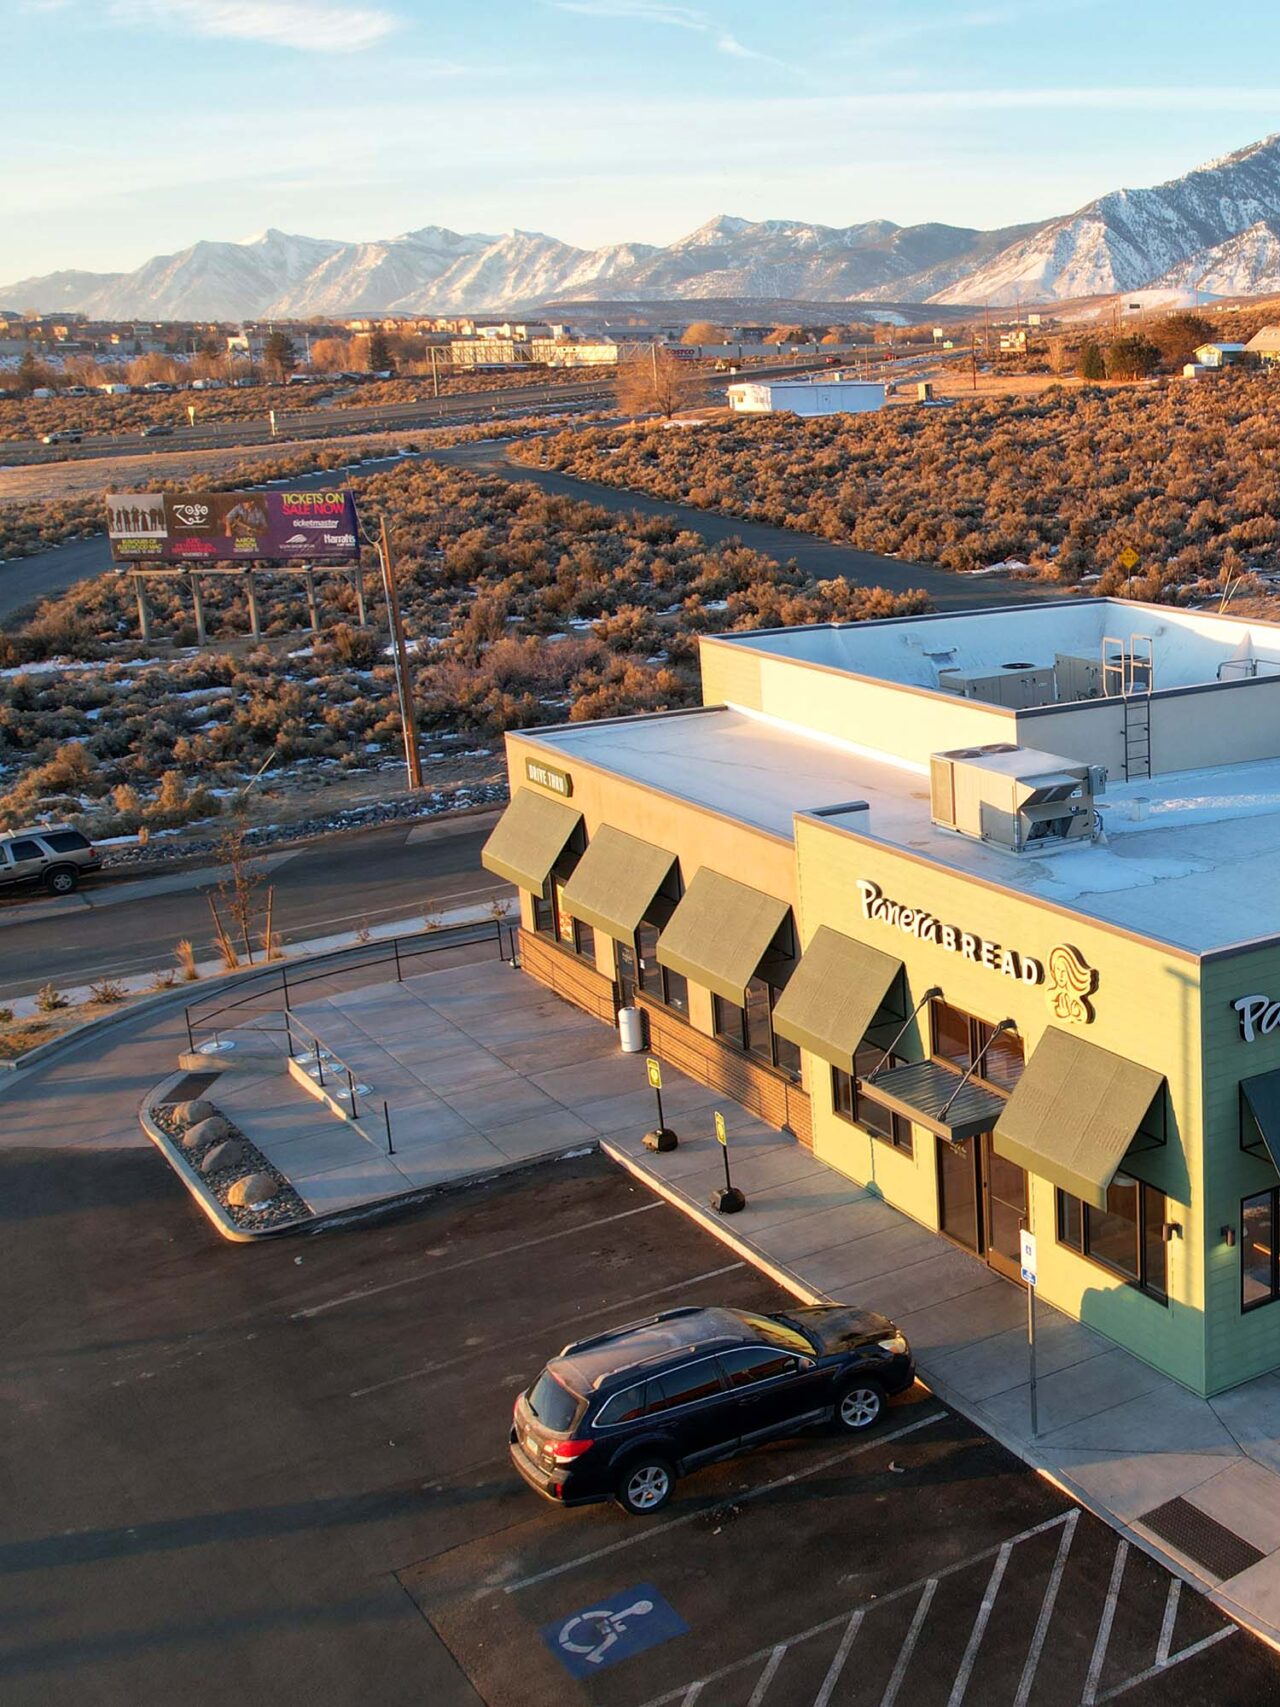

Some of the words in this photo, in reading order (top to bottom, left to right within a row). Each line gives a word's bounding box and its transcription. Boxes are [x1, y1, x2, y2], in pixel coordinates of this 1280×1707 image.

[281, 493, 323, 505] TICKETS
[325, 493, 344, 504] ON
[282, 503, 310, 515] SALE
[314, 503, 345, 514] NOW
[293, 519, 339, 528] ticketmaster
[528, 764, 547, 785] DRIVE
[547, 771, 564, 793] THRU
[856, 879, 939, 944] Panera
[941, 925, 1039, 986] BREAD
